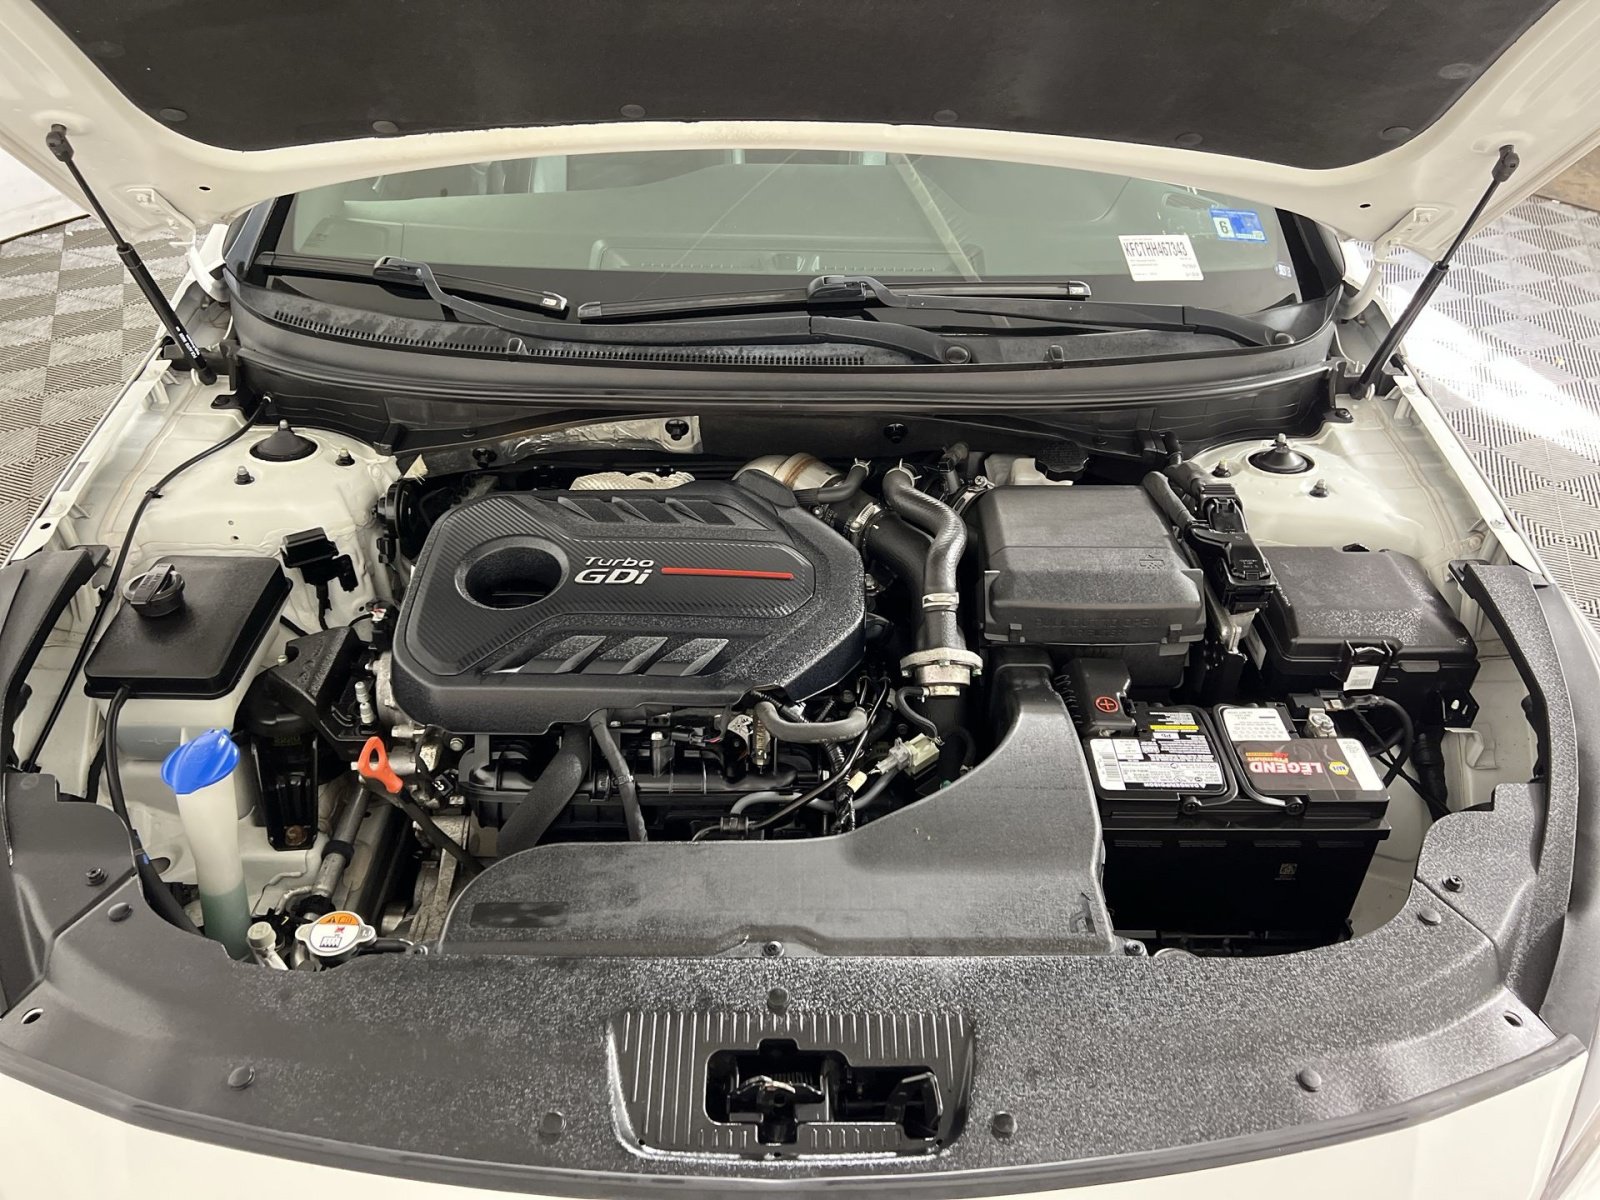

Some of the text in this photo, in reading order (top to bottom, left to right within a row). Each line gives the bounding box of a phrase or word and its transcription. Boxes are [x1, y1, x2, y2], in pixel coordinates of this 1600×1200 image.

[1219, 221, 1229, 234] 6
[1123, 241, 1188, 257] KFCTHH467343
[584, 556, 655, 568] Turbo
[574, 568, 653, 585] GDi
[1248, 761, 1323, 774] LEGEND
